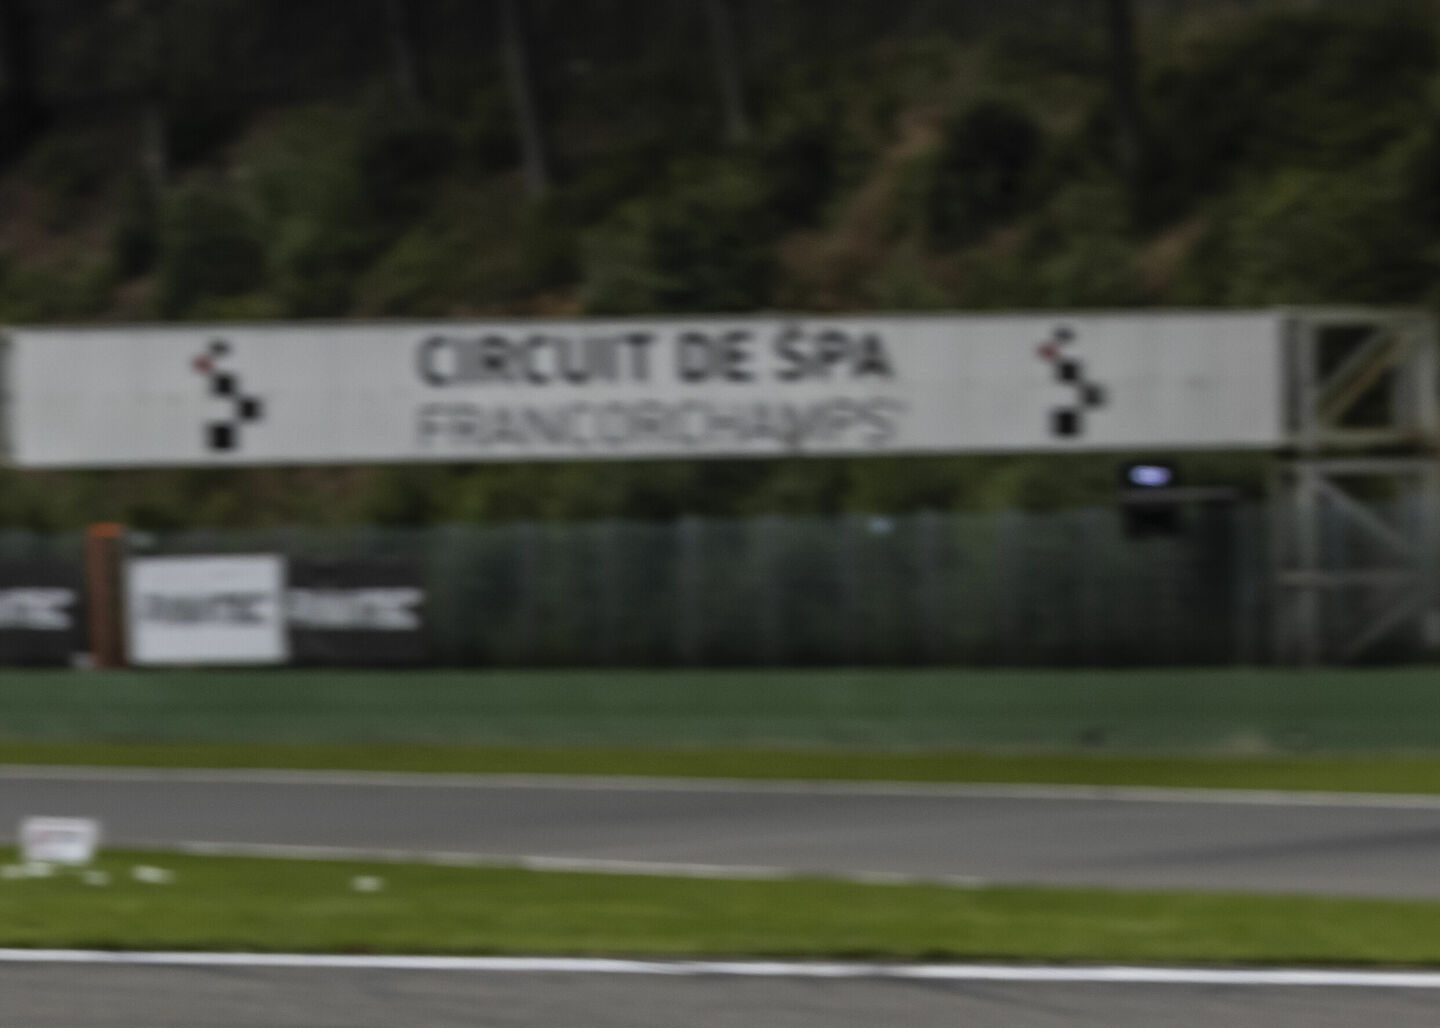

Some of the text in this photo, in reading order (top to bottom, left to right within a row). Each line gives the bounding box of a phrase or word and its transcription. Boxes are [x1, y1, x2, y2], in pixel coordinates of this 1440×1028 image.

[417, 327, 895, 388] CIRCUIT DE SPA
[417, 402, 901, 446] FRANCORCHAMPS
